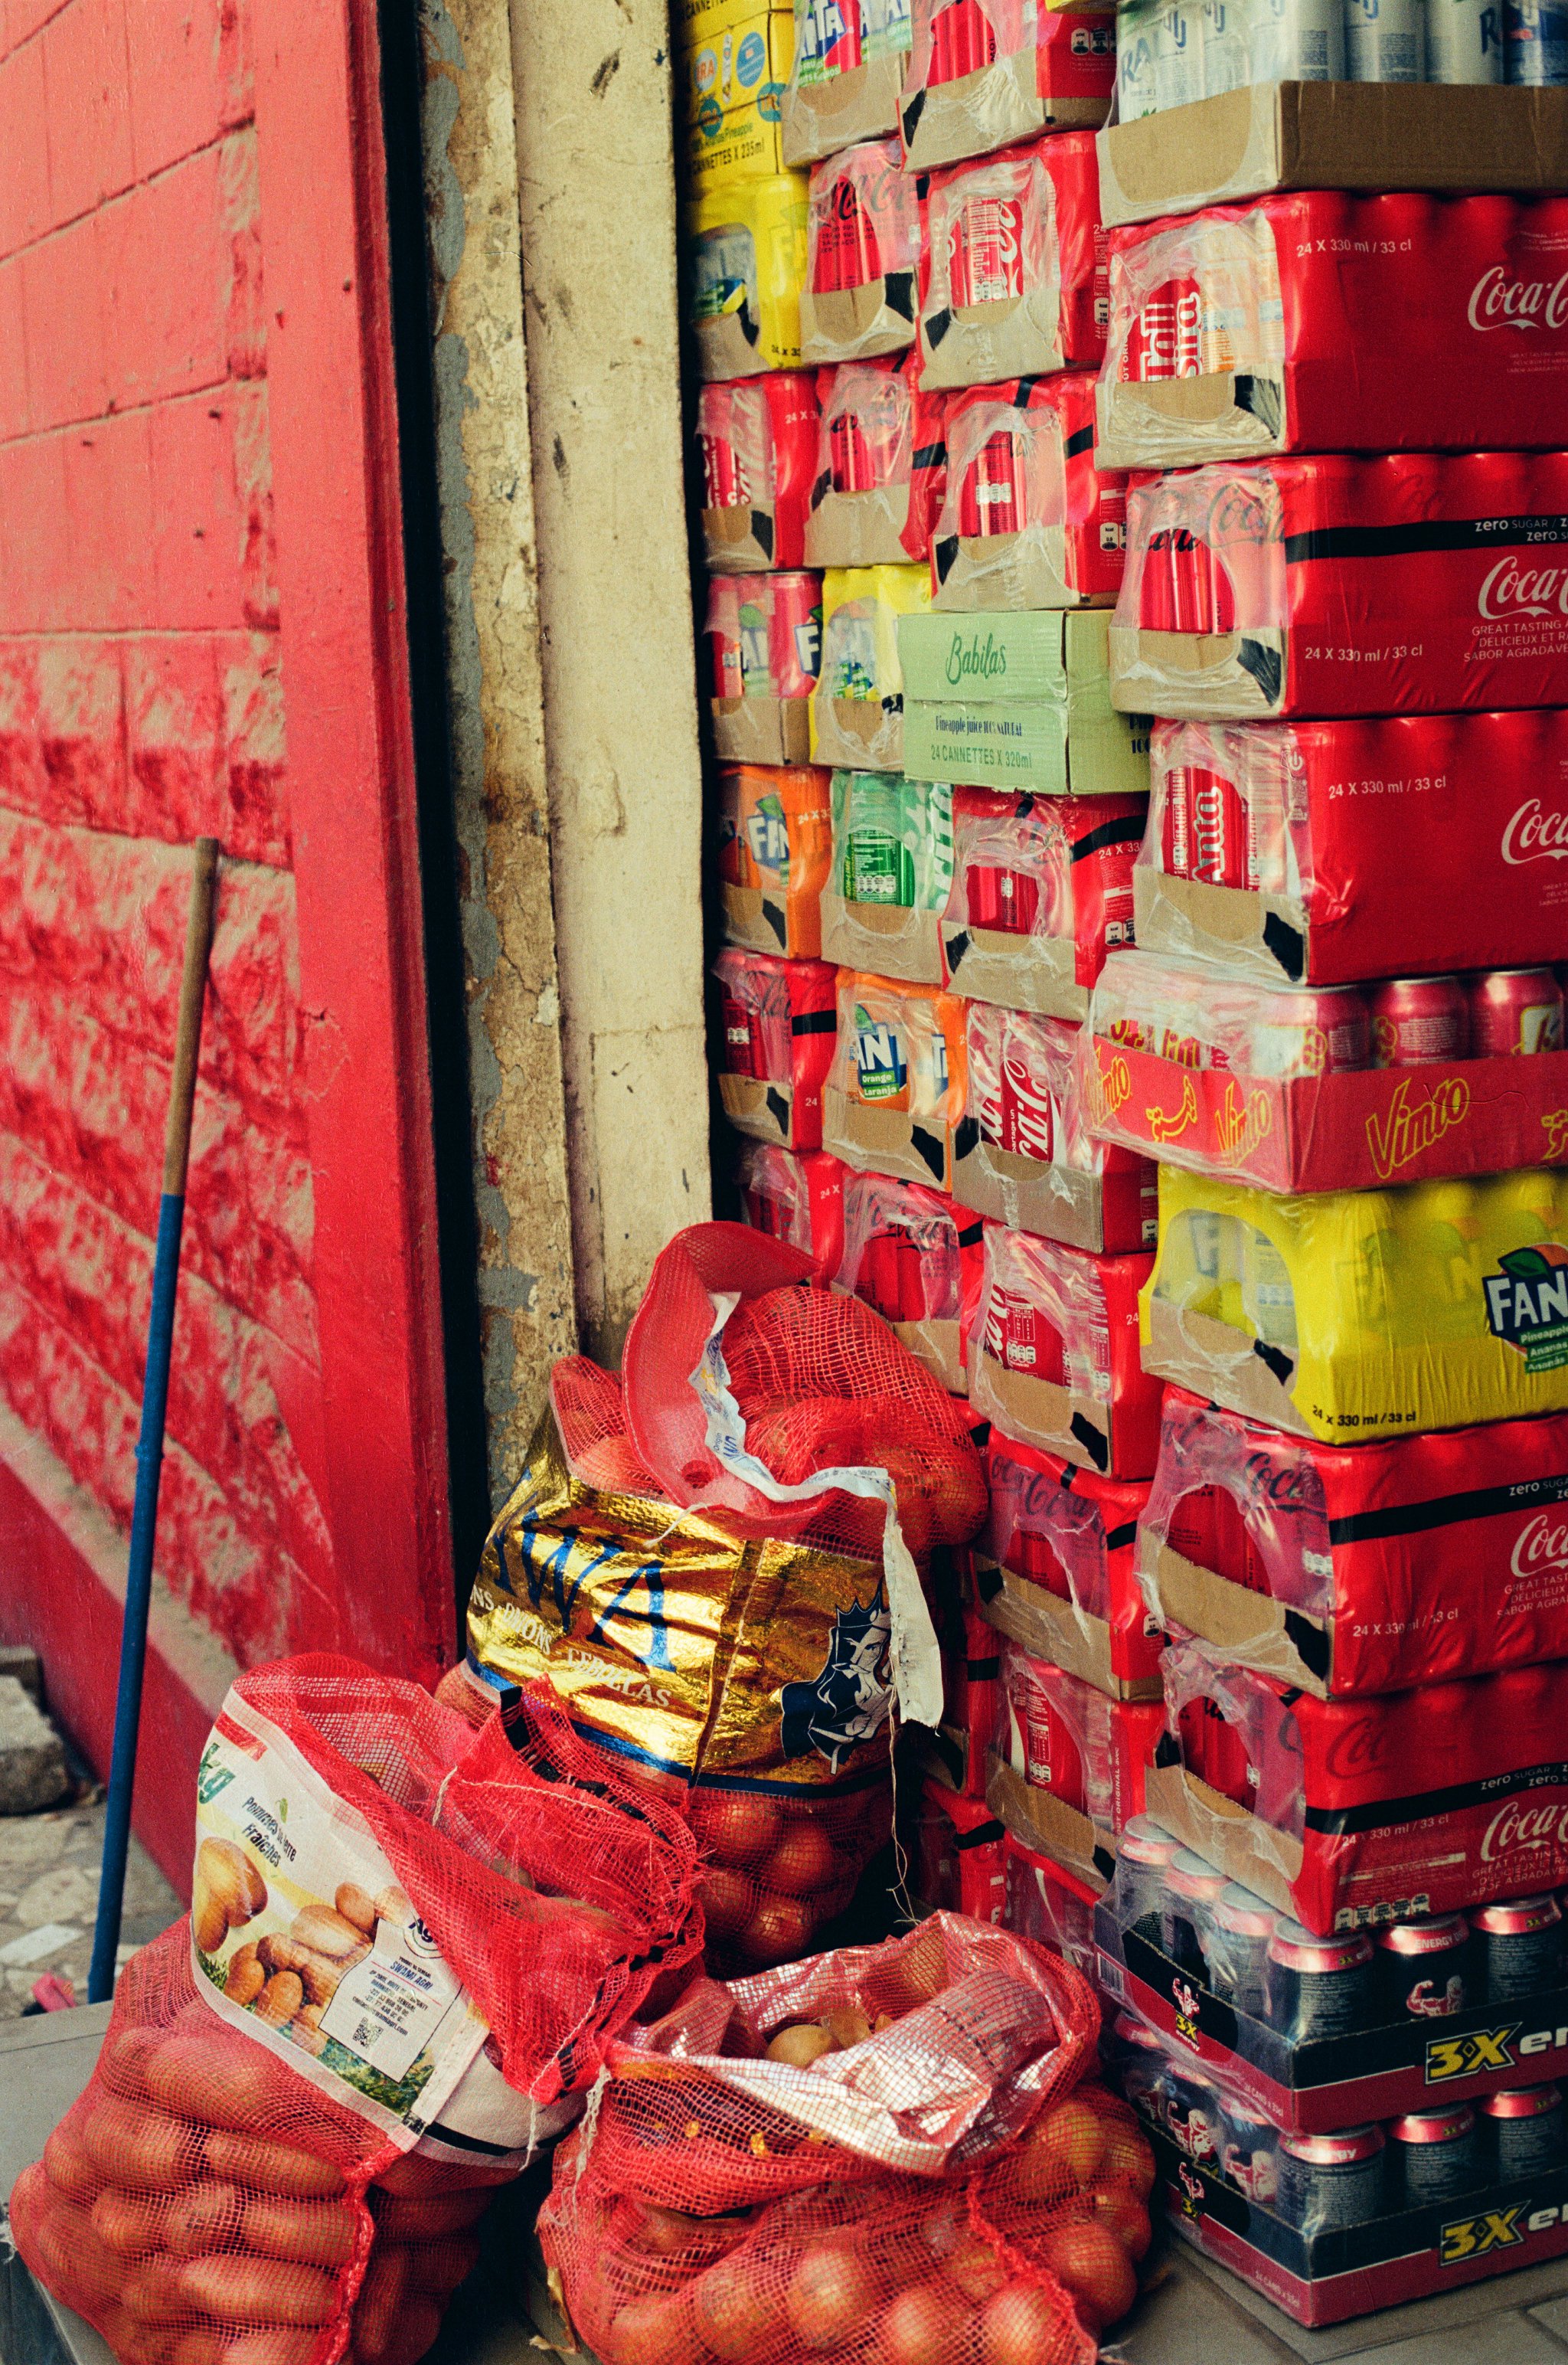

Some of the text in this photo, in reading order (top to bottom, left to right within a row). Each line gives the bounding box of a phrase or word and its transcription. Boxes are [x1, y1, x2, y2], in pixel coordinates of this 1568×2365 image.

[1296, 242, 1313, 258] 24
[1316, 240, 1326, 253] X
[1331, 239, 1352, 253] 330
[1354, 240, 1369, 254] ml
[1380, 240, 1396, 255] 33
[1400, 238, 1412, 253] cl
[1475, 520, 1508, 532] zero
[1512, 519, 1548, 529] SUGAR
[1527, 531, 1557, 542] zero
[1472, 619, 1561, 636] GREAT TASTING
[1541, 632, 1554, 643] ET
[946, 630, 1007, 685] Babilas
[1305, 647, 1320, 660] 24
[1325, 648, 1333, 660] X
[1338, 648, 1361, 662] 330
[1364, 649, 1380, 662] ml
[1392, 646, 1407, 659] 33
[1411, 644, 1423, 656] cl
[1464, 649, 1503, 662] SABOR
[966, 718, 982, 737] juice
[931, 744, 940, 761] 24
[941, 745, 995, 766] CANNETTES
[998, 750, 1003, 766] X
[1328, 784, 1343, 800] 24
[1349, 782, 1357, 796] X
[1361, 780, 1383, 794] 330
[1387, 779, 1403, 793] ml
[1415, 777, 1431, 791] 33
[1435, 775, 1446, 788] cl
[1099, 849, 1111, 860] 24
[1116, 845, 1123, 855] X
[862, 1074, 892, 1084] Orange
[864, 1086, 897, 1097] Laranja
[805, 1097, 818, 1107] 24
[1010, 1108, 1015, 1118] un
[820, 1184, 840, 1199] 24 X
[1126, 1313, 1139, 1325] 24
[1312, 1405, 1322, 1419] 24
[1326, 1415, 1333, 1425] x
[1338, 1414, 1359, 1427] 330
[1363, 1413, 1378, 1425] ml
[1388, 1412, 1403, 1424] 33
[1405, 1411, 1416, 1422] cl
[714, 1432, 722, 1452] Origin
[1509, 1481, 1540, 1497] zero
[1504, 1580, 1540, 1595] GREAT
[1497, 1603, 1533, 1619] SABOR
[1353, 1625, 1368, 1637] 24
[1373, 1624, 1381, 1635] X
[1447, 1608, 1459, 1620] cl
[502, 1602, 552, 1655] ONIONS
[567, 1647, 672, 1709] CEBOLLAS
[1481, 1775, 1511, 1791] zero
[1528, 1775, 1558, 1788] zero
[242, 1796, 279, 1836] Pommes
[1343, 1835, 1357, 1847] 24
[1370, 1827, 1391, 1840] 330
[1420, 1817, 1435, 1830] 33
[242, 1823, 281, 1868] Fraîches
[1415, 1935, 1453, 1950] ENERGY
[390, 1961, 417, 1981] SWAMI
[414, 1976, 433, 1990] AGRI
[1428, 2027, 1514, 2079] 3X
[1442, 2206, 1521, 2261] 3X
